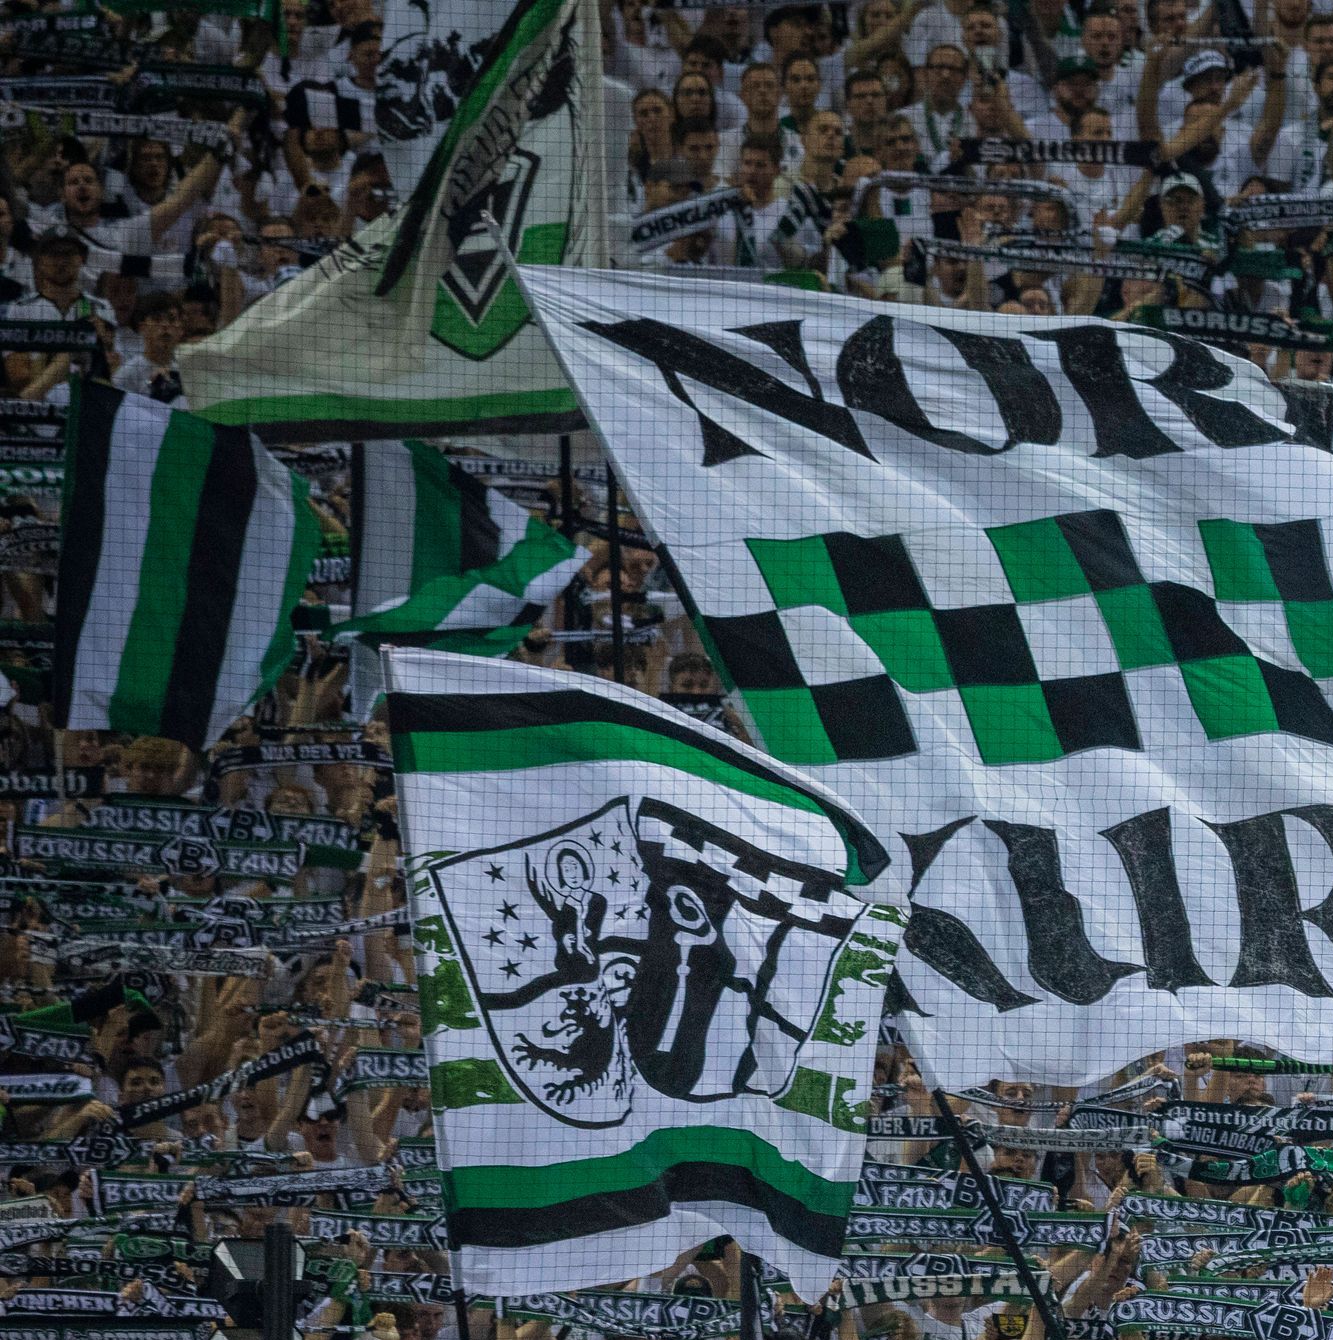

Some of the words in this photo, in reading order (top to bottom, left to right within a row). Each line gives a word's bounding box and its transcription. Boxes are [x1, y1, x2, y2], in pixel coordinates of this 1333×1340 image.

[20, 839, 152, 862] BORUSSIA
[227, 854, 298, 873] FANS
[871, 1117, 904, 1134] DER
[909, 1117, 938, 1134] VFL
